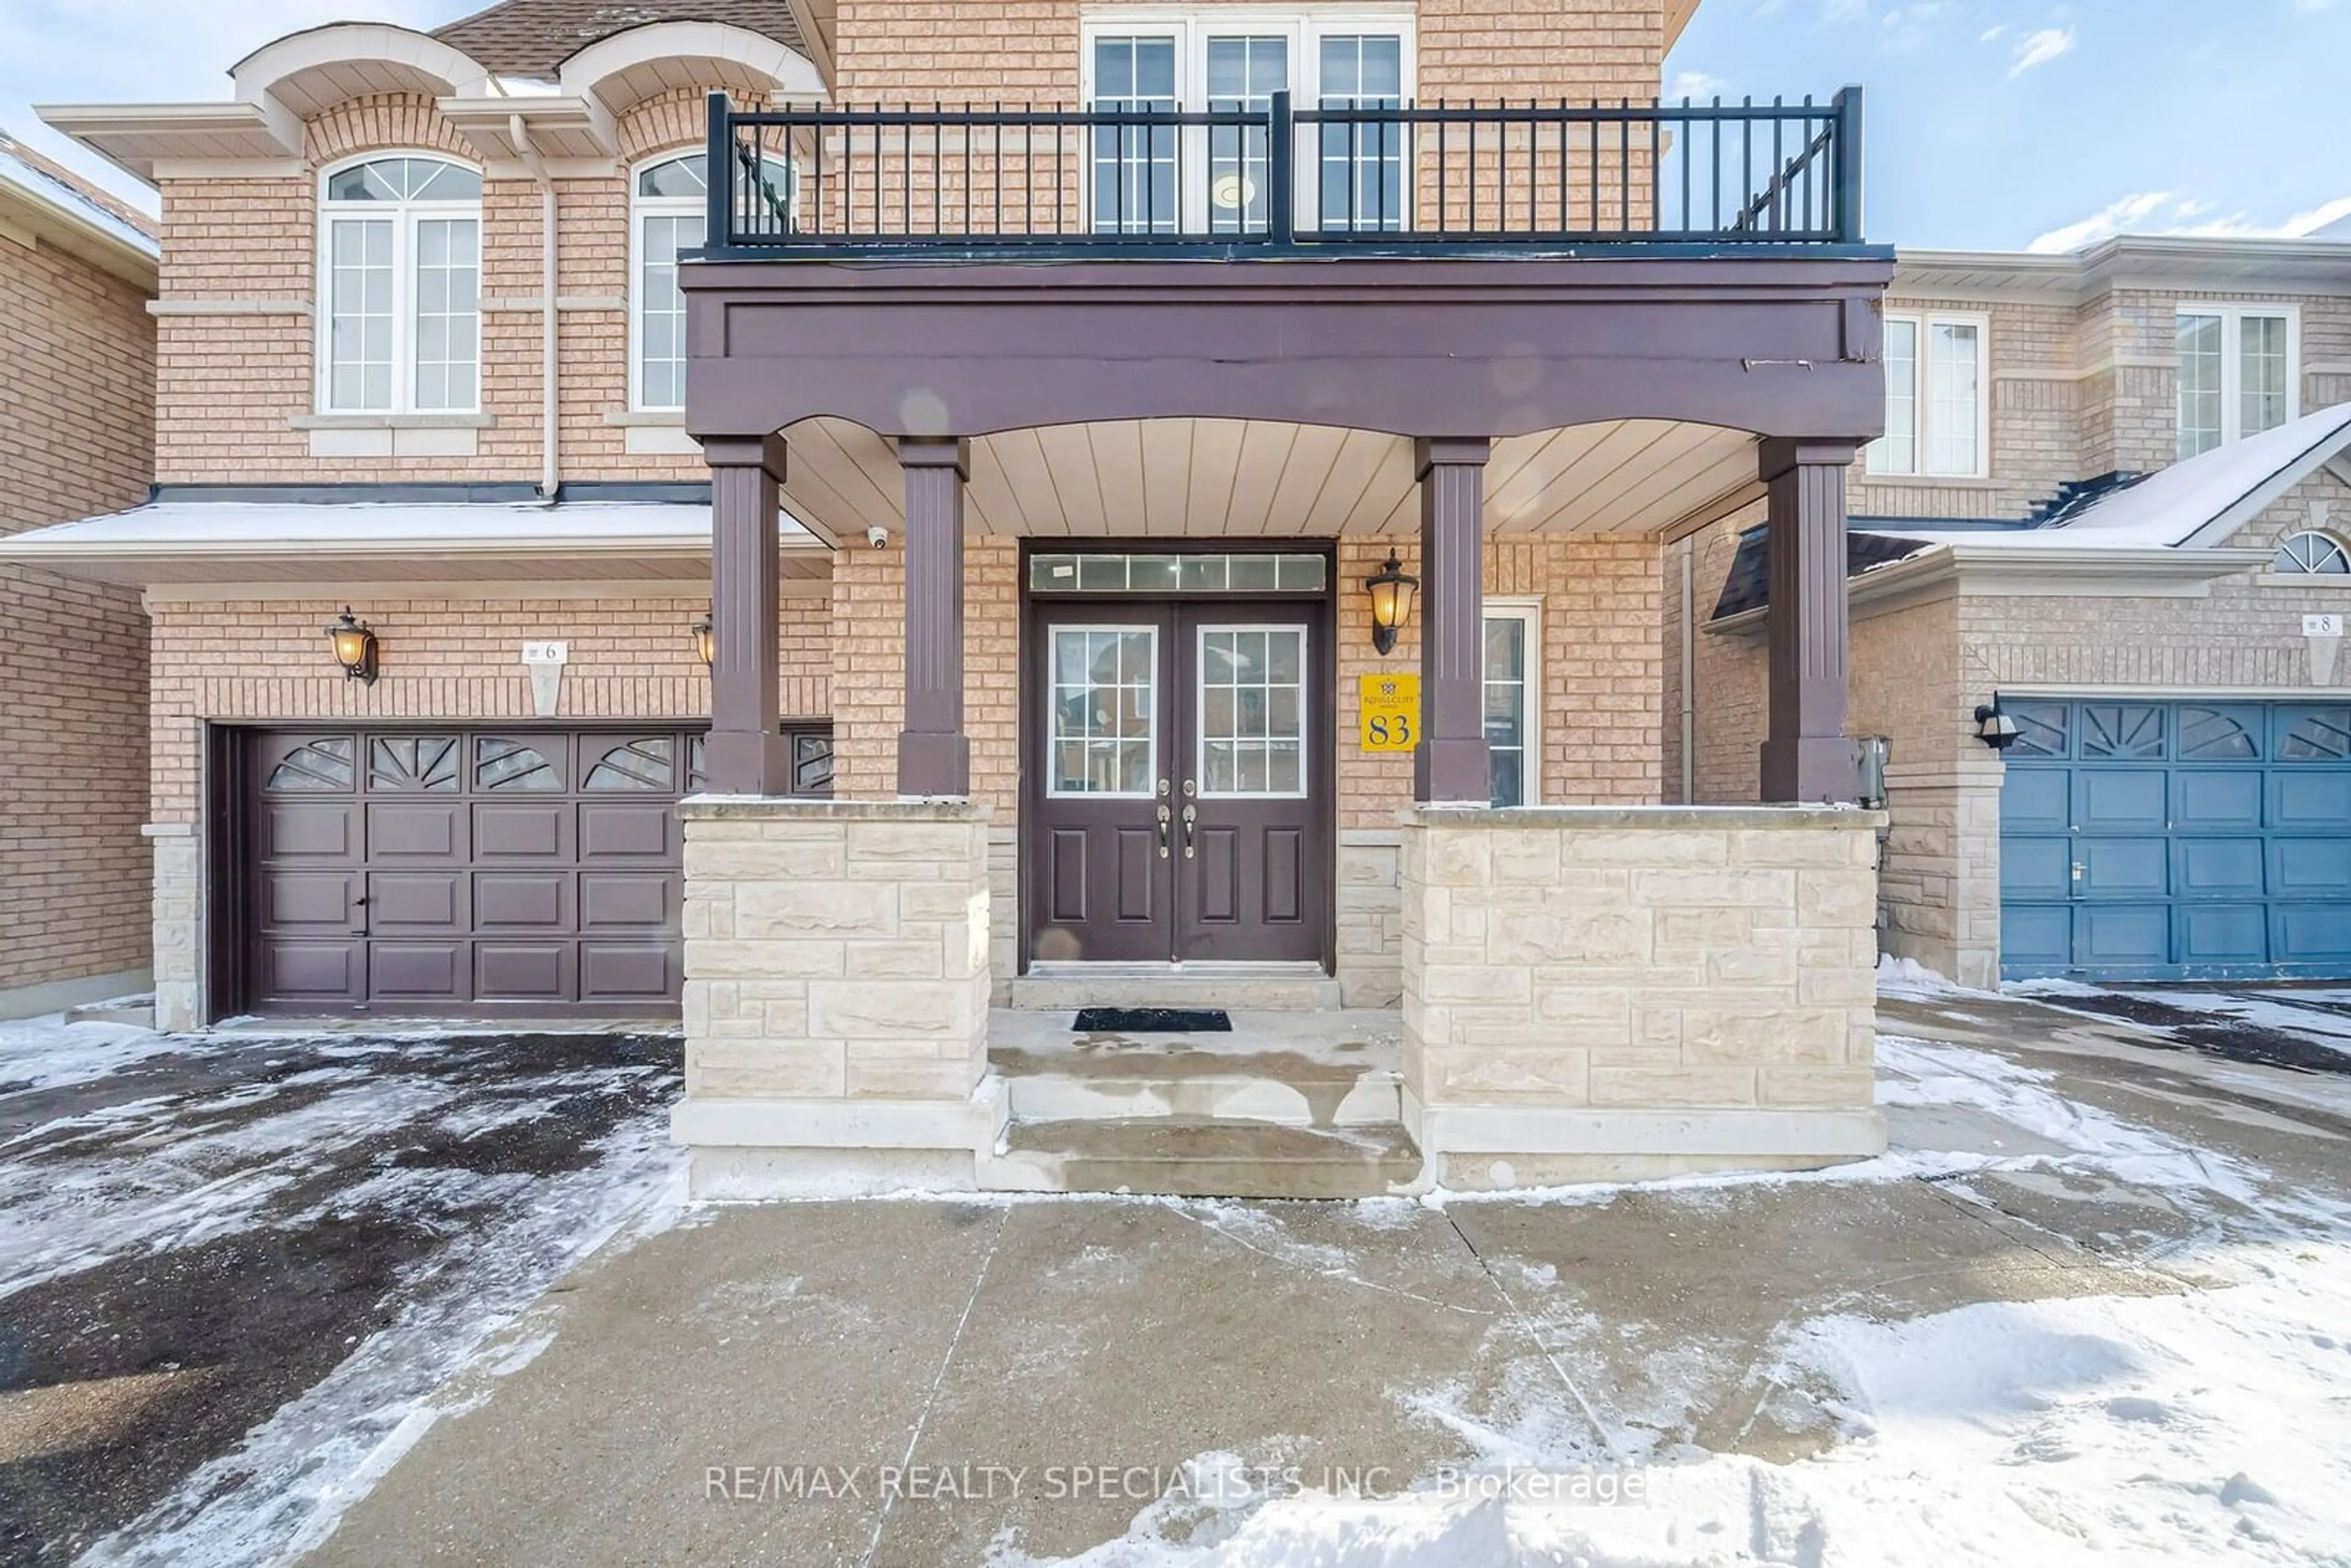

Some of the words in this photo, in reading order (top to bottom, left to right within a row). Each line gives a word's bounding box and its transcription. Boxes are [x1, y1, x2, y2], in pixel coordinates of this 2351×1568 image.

[2322, 615, 2330, 631] 8
[546, 643, 557, 659] 6
[1369, 715, 1409, 745] 83
